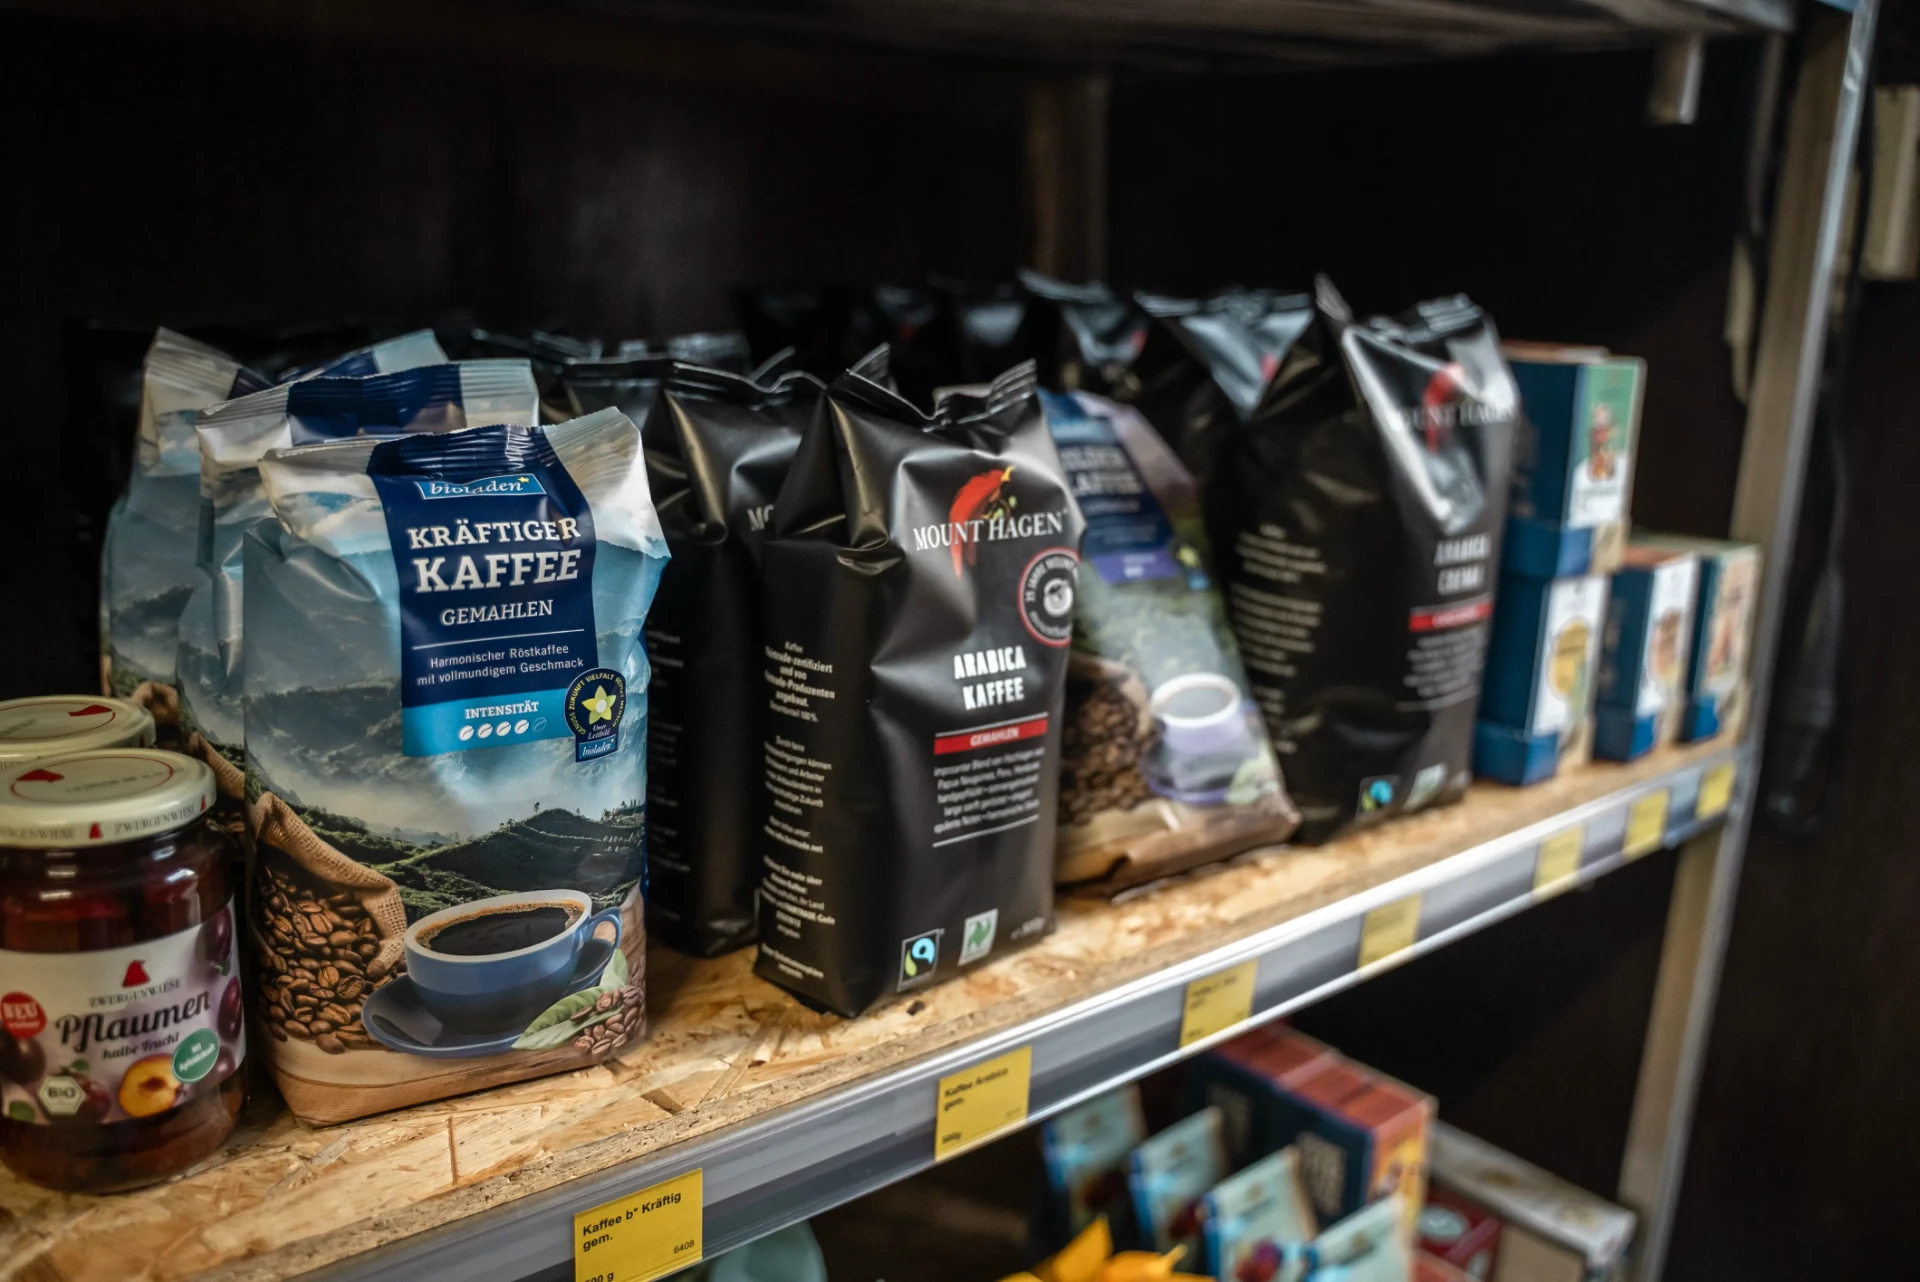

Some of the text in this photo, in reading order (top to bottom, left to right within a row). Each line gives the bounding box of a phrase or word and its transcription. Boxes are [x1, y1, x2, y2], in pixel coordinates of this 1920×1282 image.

[430, 479, 524, 496] bioladen
[407, 517, 582, 549] KRÄFTIGER
[912, 519, 984, 551] MOUNT
[987, 511, 1064, 541] HAGEN
[412, 549, 582, 594] KAFFEE
[439, 599, 554, 627] GEMAHLEN
[430, 644, 570, 669] Harmonischer Röstkaffee
[953, 645, 1028, 680] ARABICA
[416, 656, 585, 687] mit vollmundigem Geschmack
[585, 672, 616, 683] VIELFALT
[568, 680, 586, 711] ZUKUNFT
[962, 676, 1025, 711] KAFFEE
[464, 699, 540, 720] INTENSITÄT
[568, 711, 587, 736] GENUSS
[581, 741, 612, 757] bioladen
[89, 978, 182, 1009] ZWERGENWIESE
[2, 1001, 38, 1020] NEU
[55, 990, 211, 1053] Pflaumen
[102, 1044, 139, 1060] halbe
[582, 1215, 623, 1237] Kaffee
[641, 1192, 682, 1214] Kräftig
[582, 1233, 614, 1253] gem.
[673, 1239, 696, 1255] 6408
